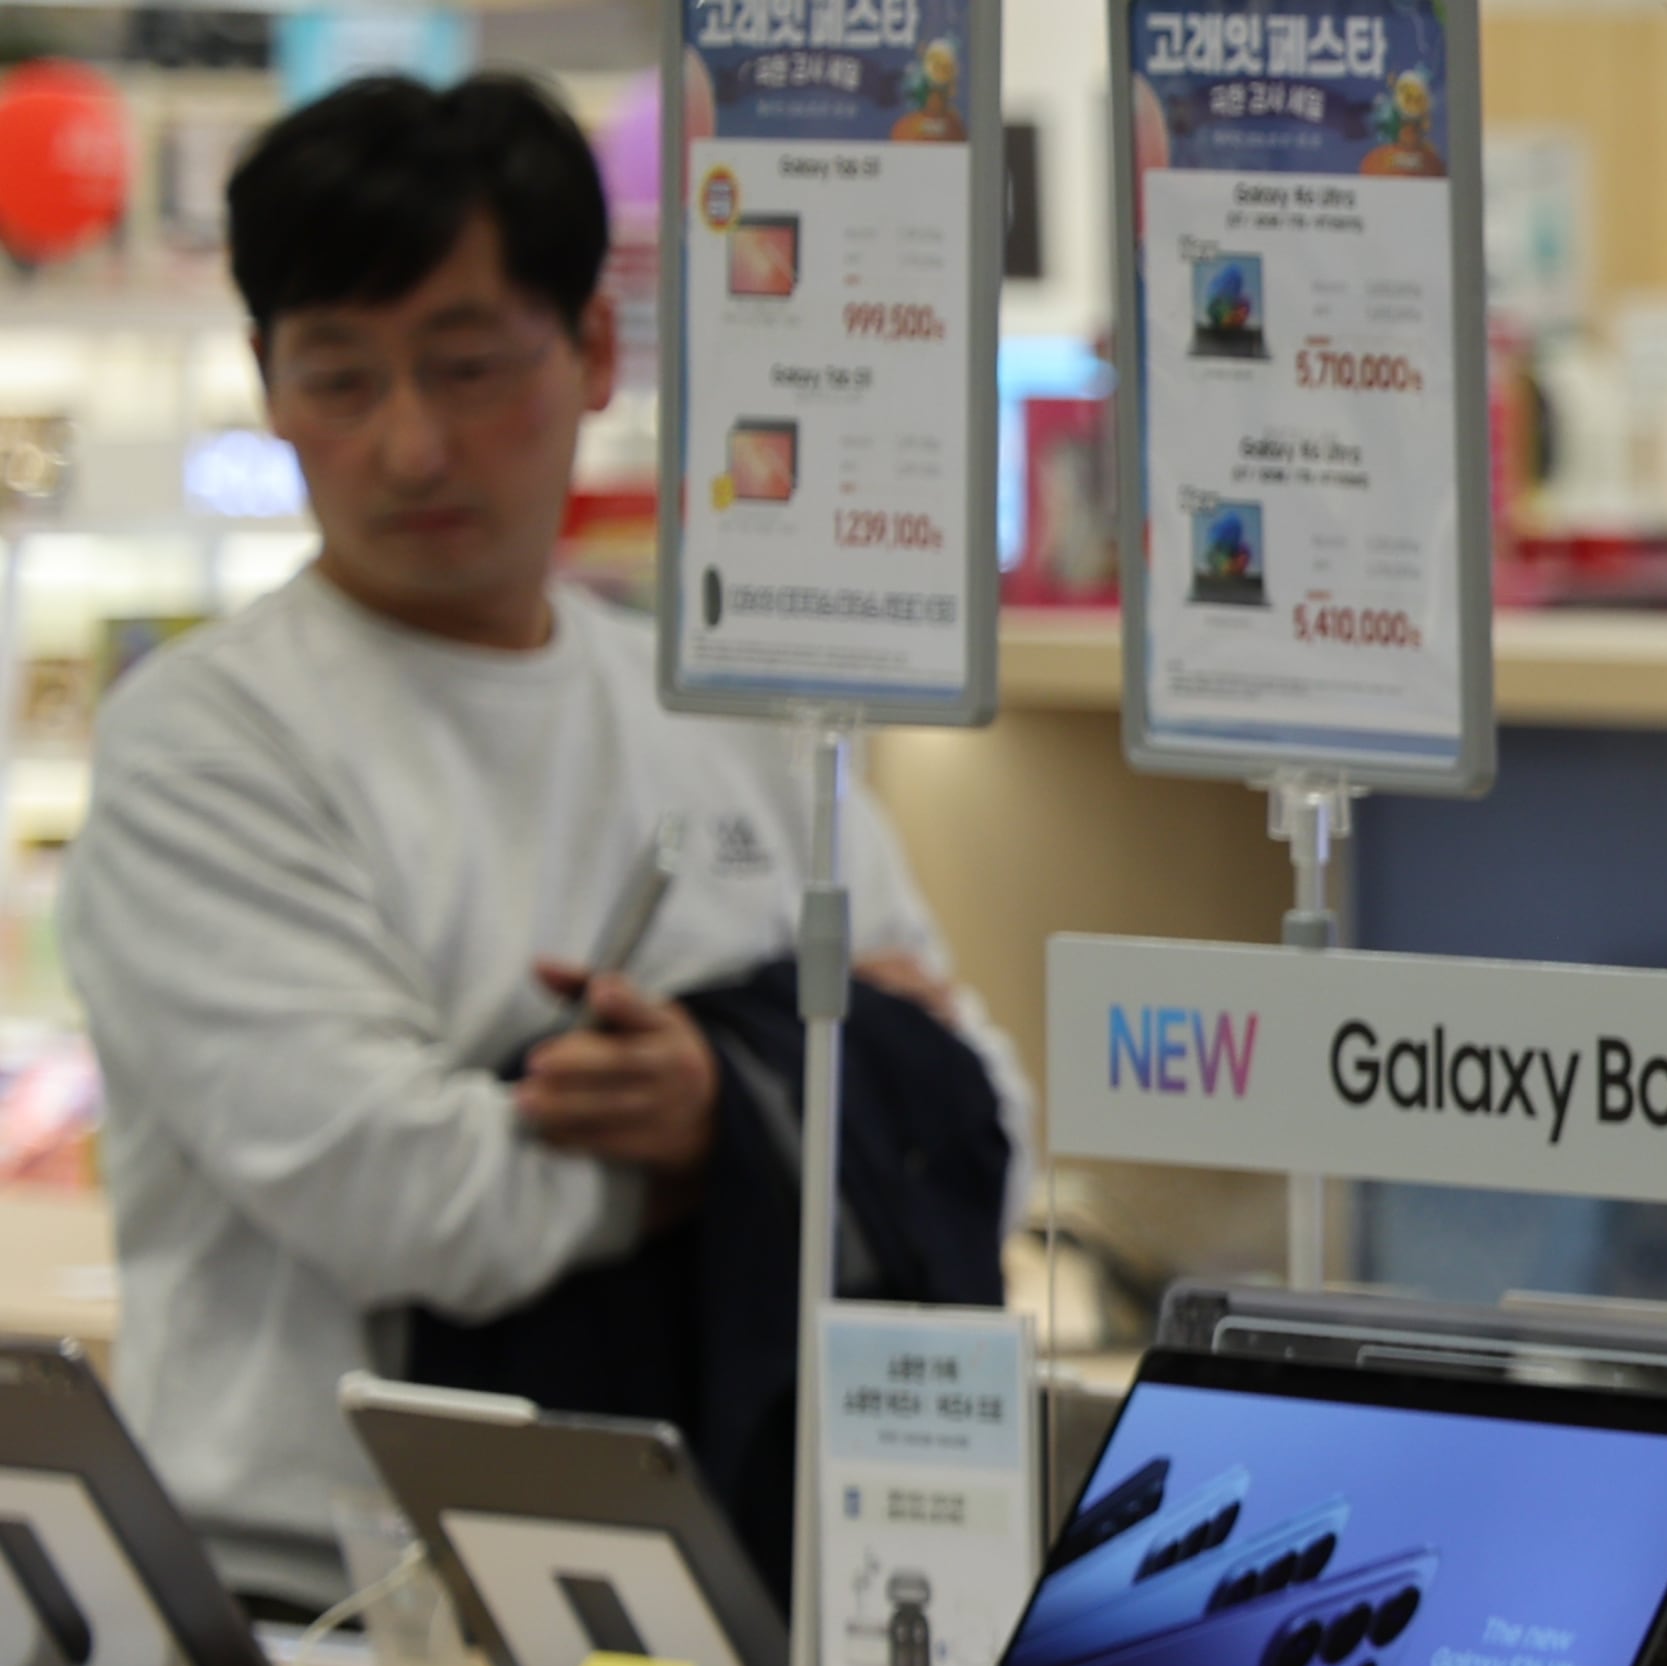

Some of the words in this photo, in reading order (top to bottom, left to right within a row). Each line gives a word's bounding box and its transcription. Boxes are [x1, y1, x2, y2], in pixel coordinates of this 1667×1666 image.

[809, 0, 917, 46] 페스타
[1146, 13, 1263, 75] 고래잇
[1267, 15, 1386, 78] 페스타
[1107, 1003, 1259, 1098] NEW
[1329, 1019, 1580, 1145] Galaxy
